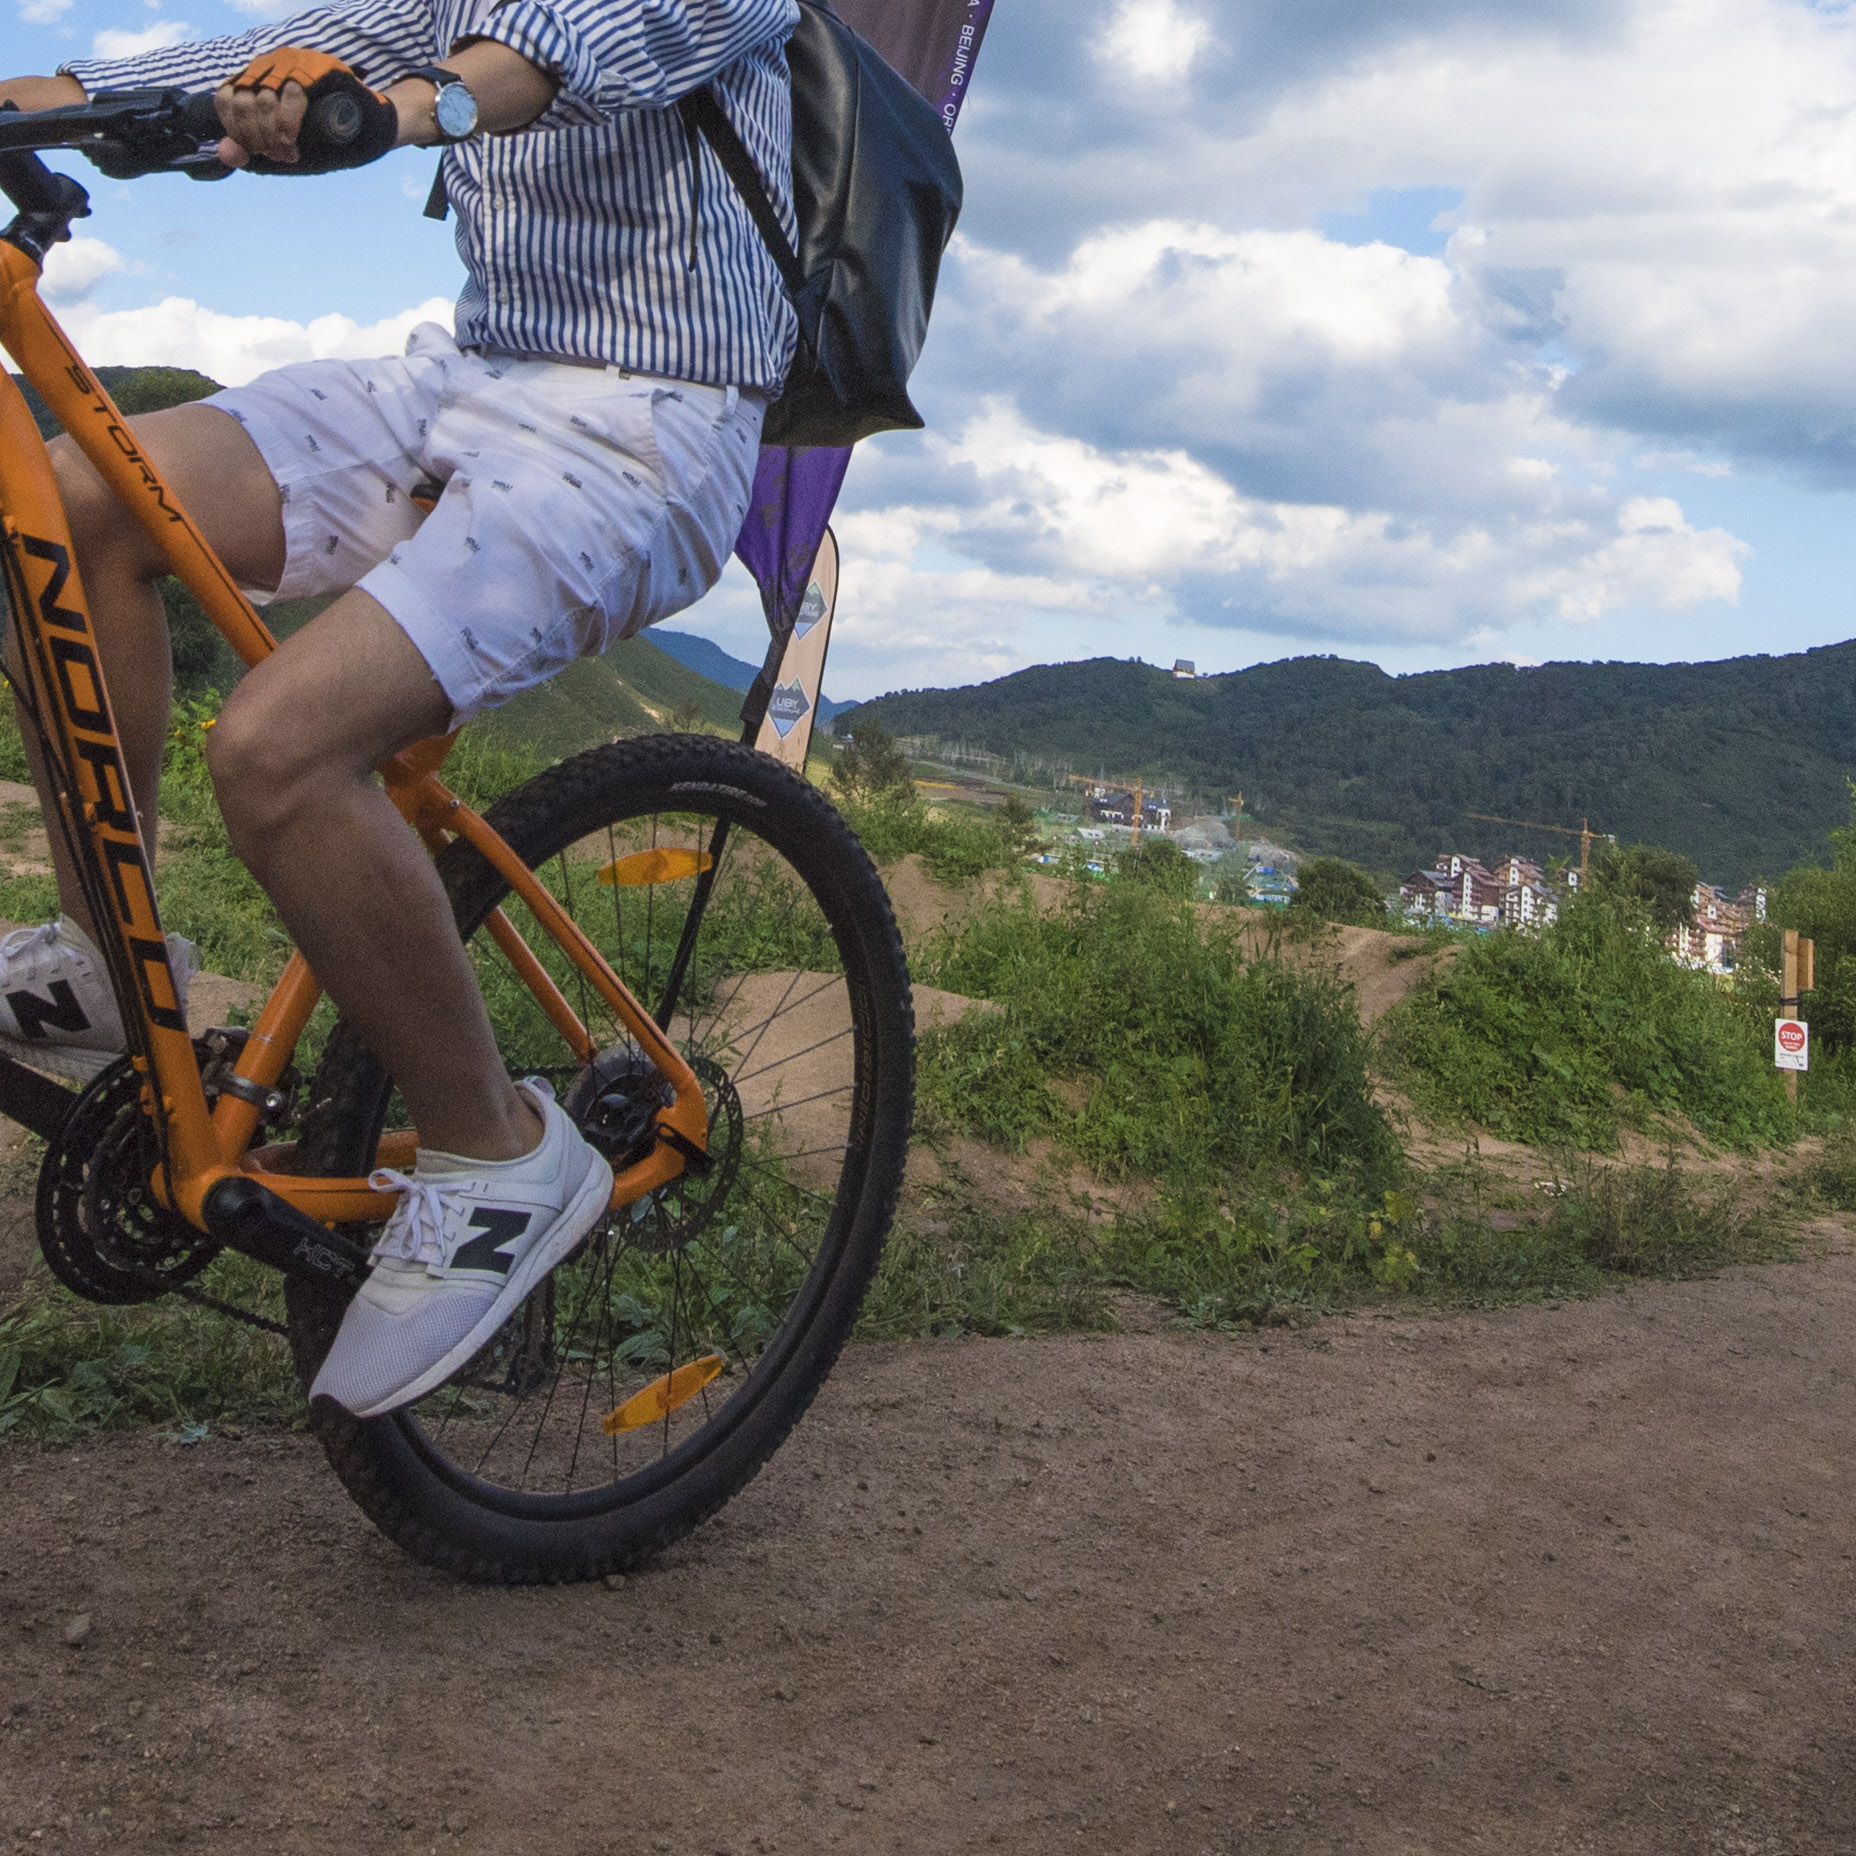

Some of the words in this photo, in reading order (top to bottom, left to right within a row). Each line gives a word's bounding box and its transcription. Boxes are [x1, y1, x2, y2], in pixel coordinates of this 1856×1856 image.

[950, 23, 975, 86] BEIJING
[64, 363, 183, 523] STORM
[22, 534, 188, 1032] NORCO
[1780, 1030, 1803, 1042] STOP
